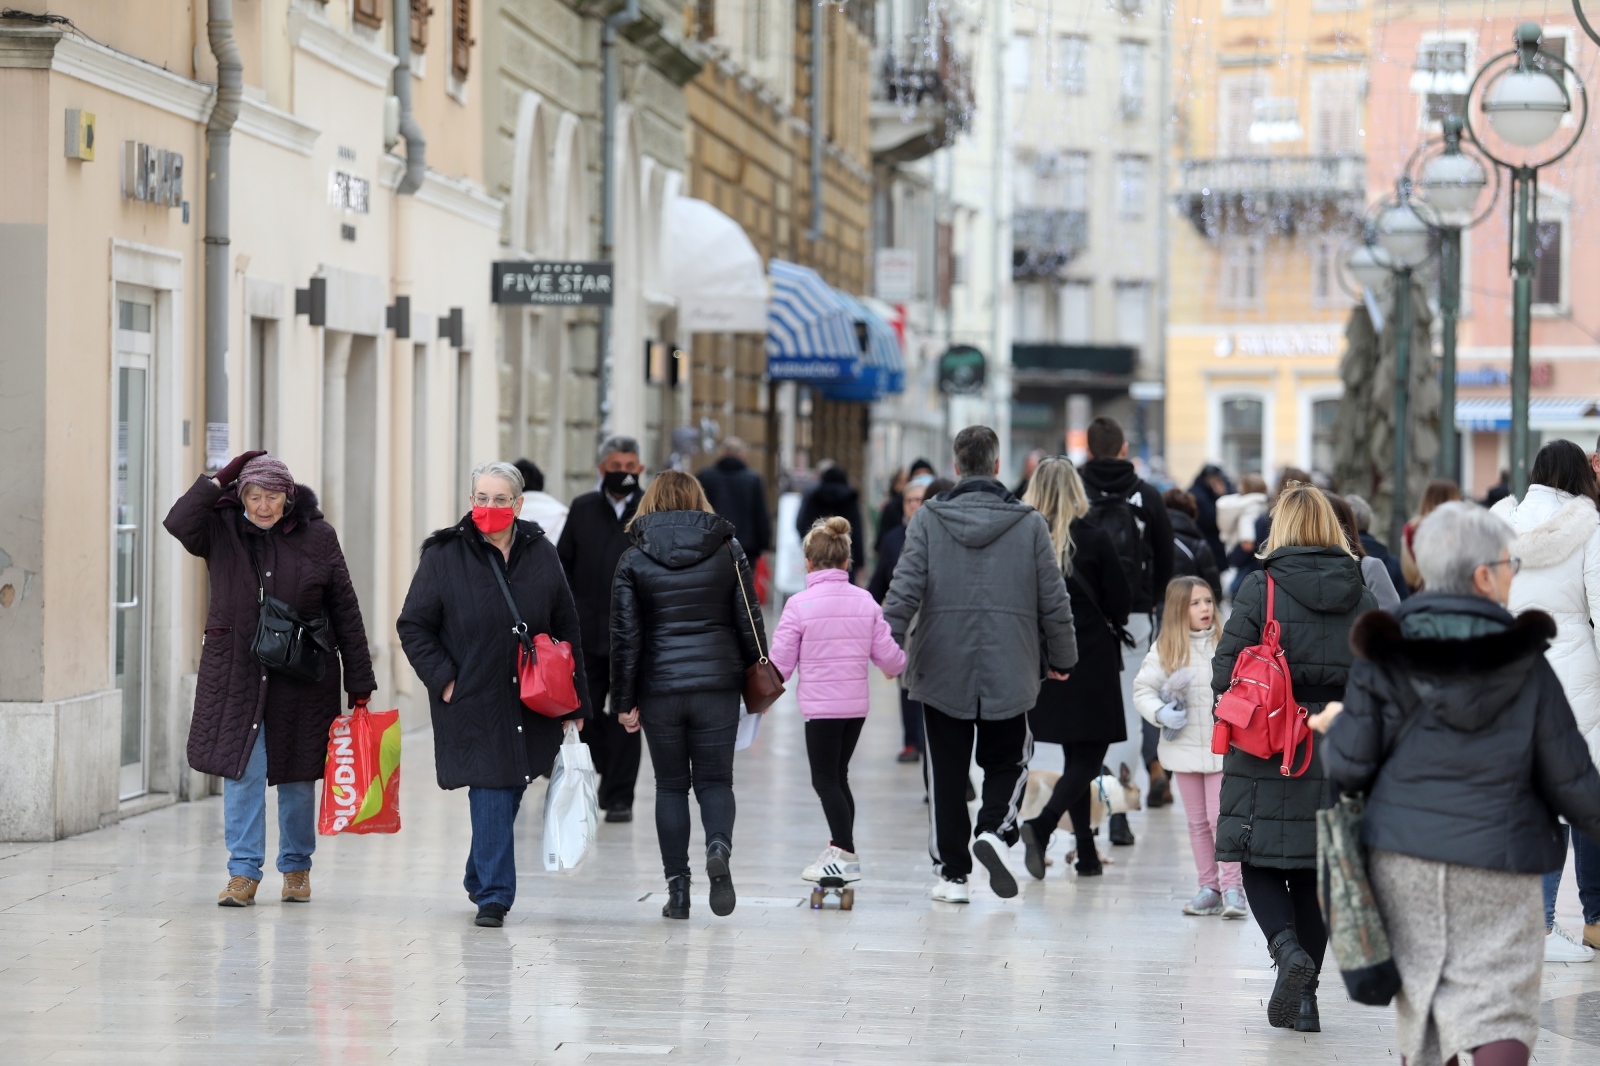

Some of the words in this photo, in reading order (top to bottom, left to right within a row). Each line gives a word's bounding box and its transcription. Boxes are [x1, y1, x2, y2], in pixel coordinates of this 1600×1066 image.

[502, 273, 553, 292] FIVE
[558, 274, 611, 293] STAR
[332, 717, 358, 832] PLODINE
